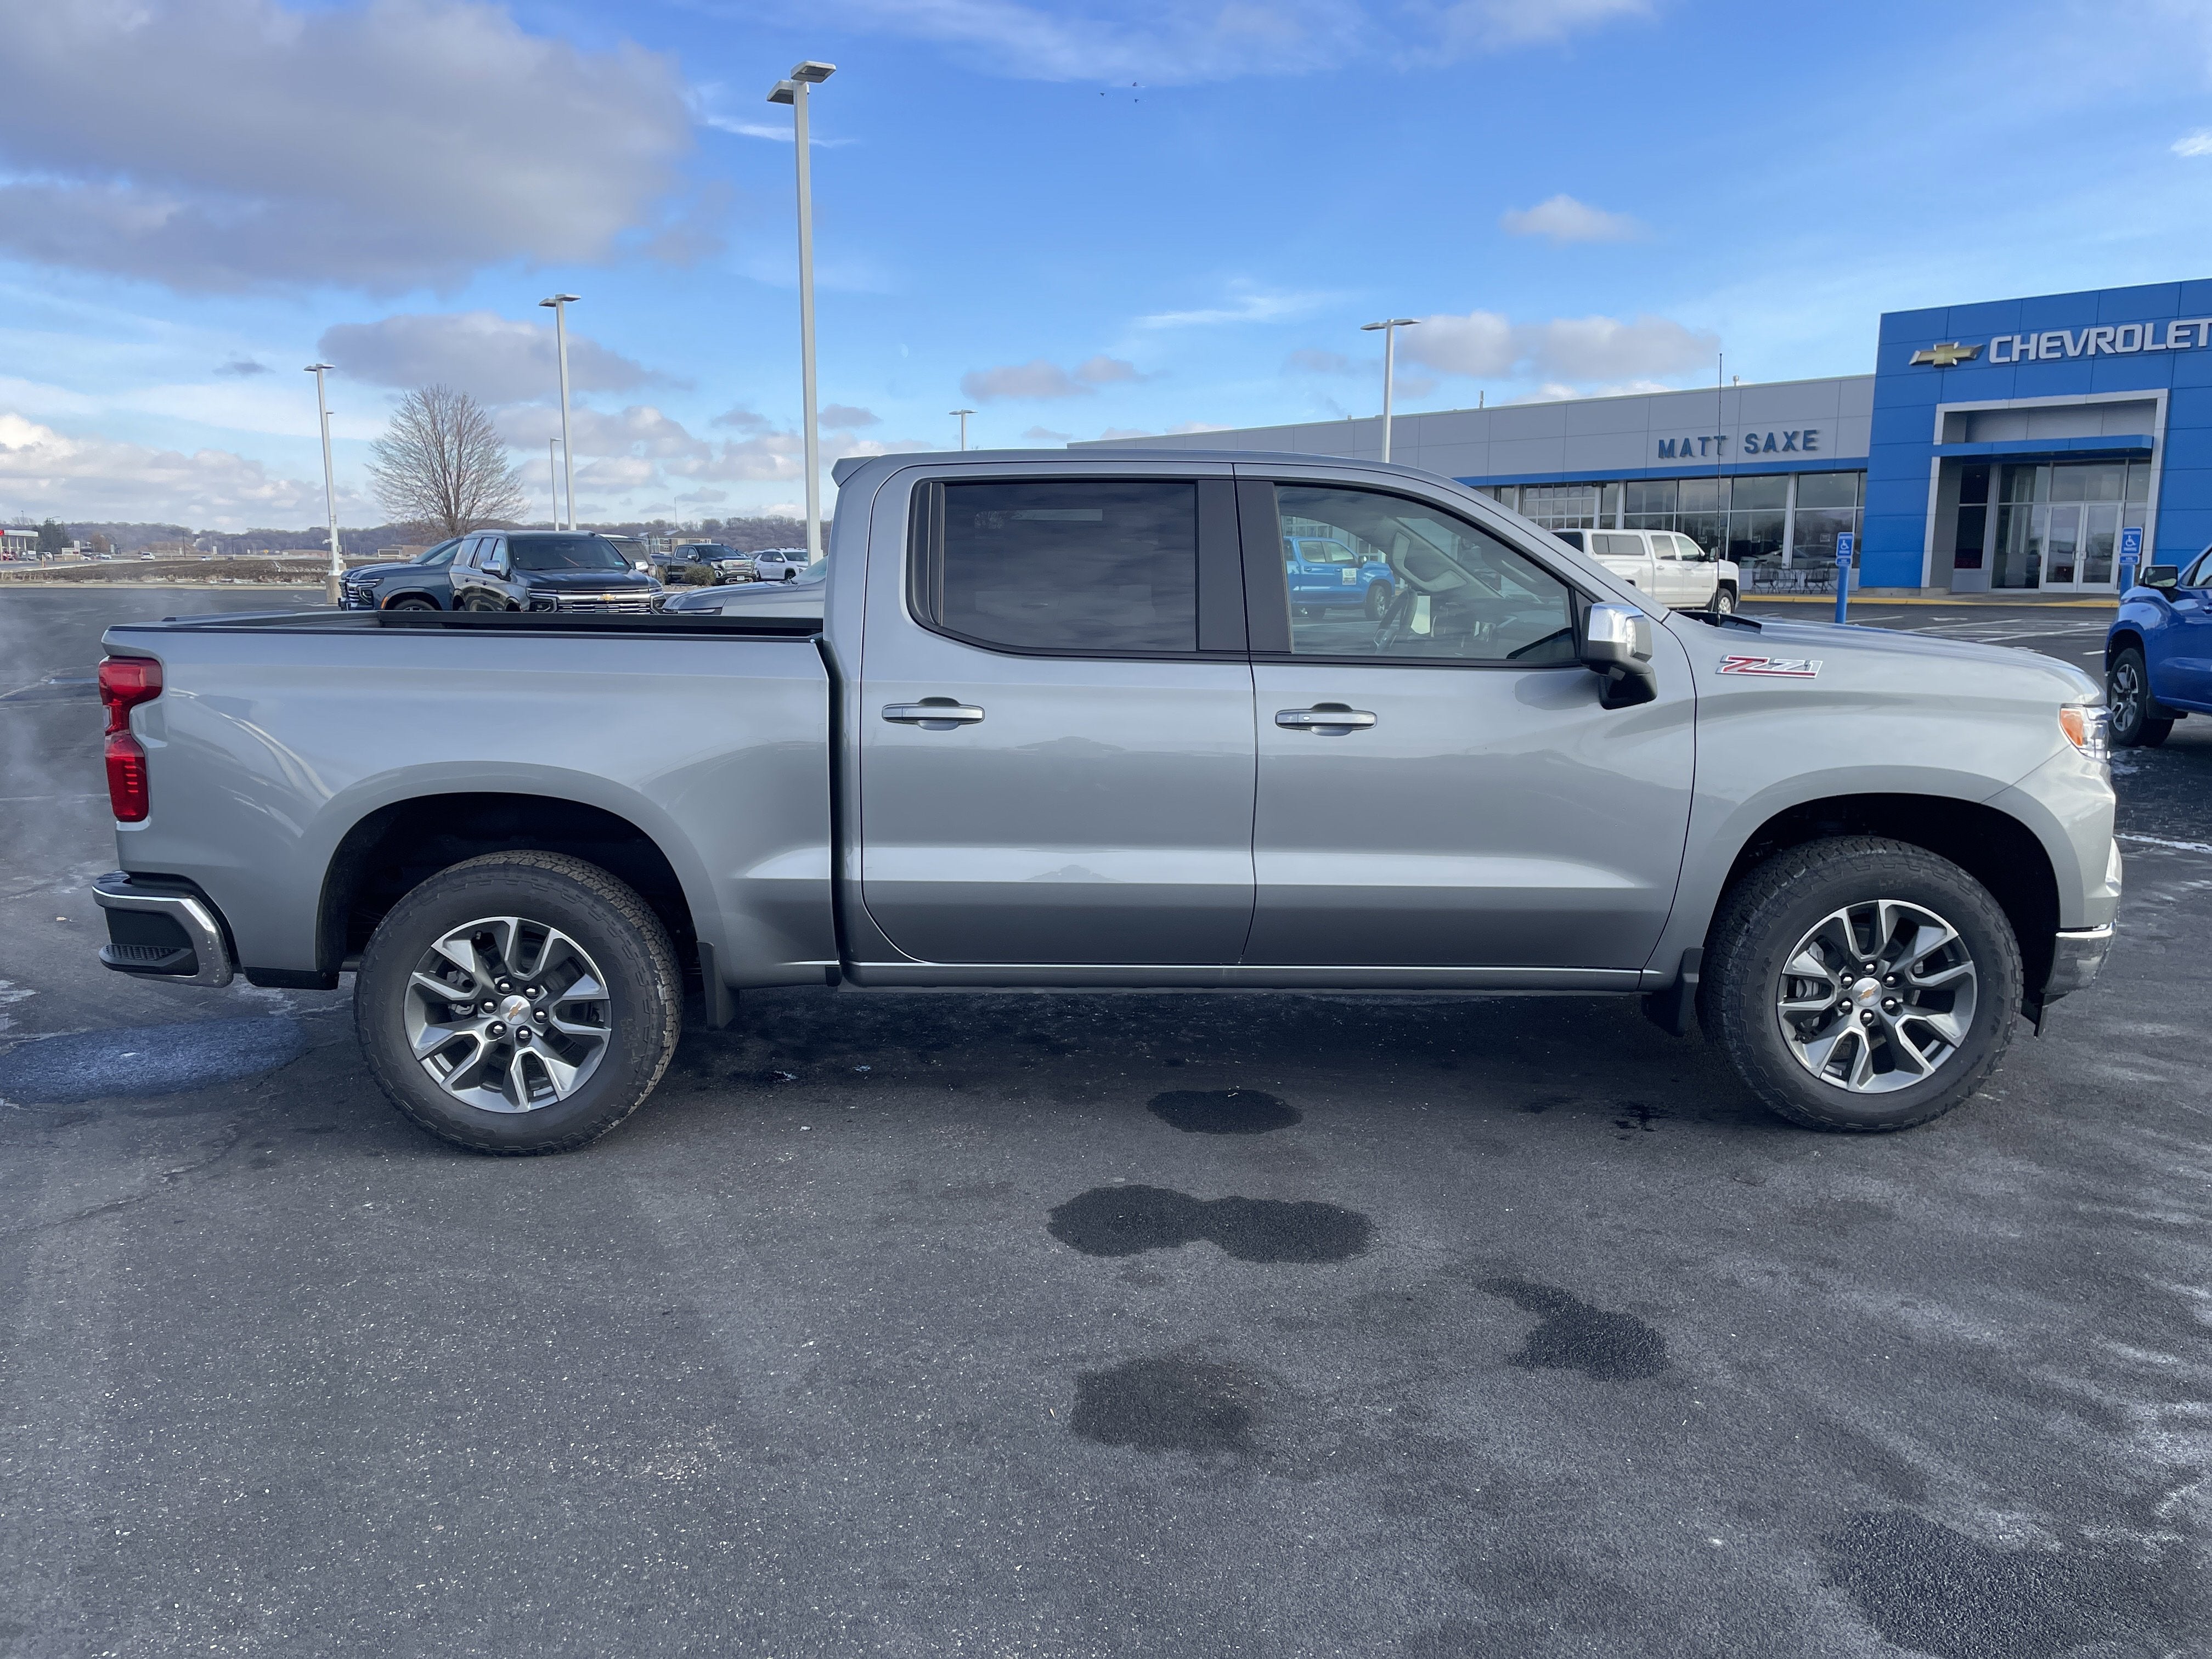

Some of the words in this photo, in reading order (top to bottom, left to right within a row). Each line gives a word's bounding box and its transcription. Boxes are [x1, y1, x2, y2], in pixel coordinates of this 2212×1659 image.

[1989, 318, 2212, 364] CHEVROLET
[1658, 436, 1726, 459] MATT
[1744, 430, 1818, 454] SAXE
[1716, 654, 1823, 679] Z71
